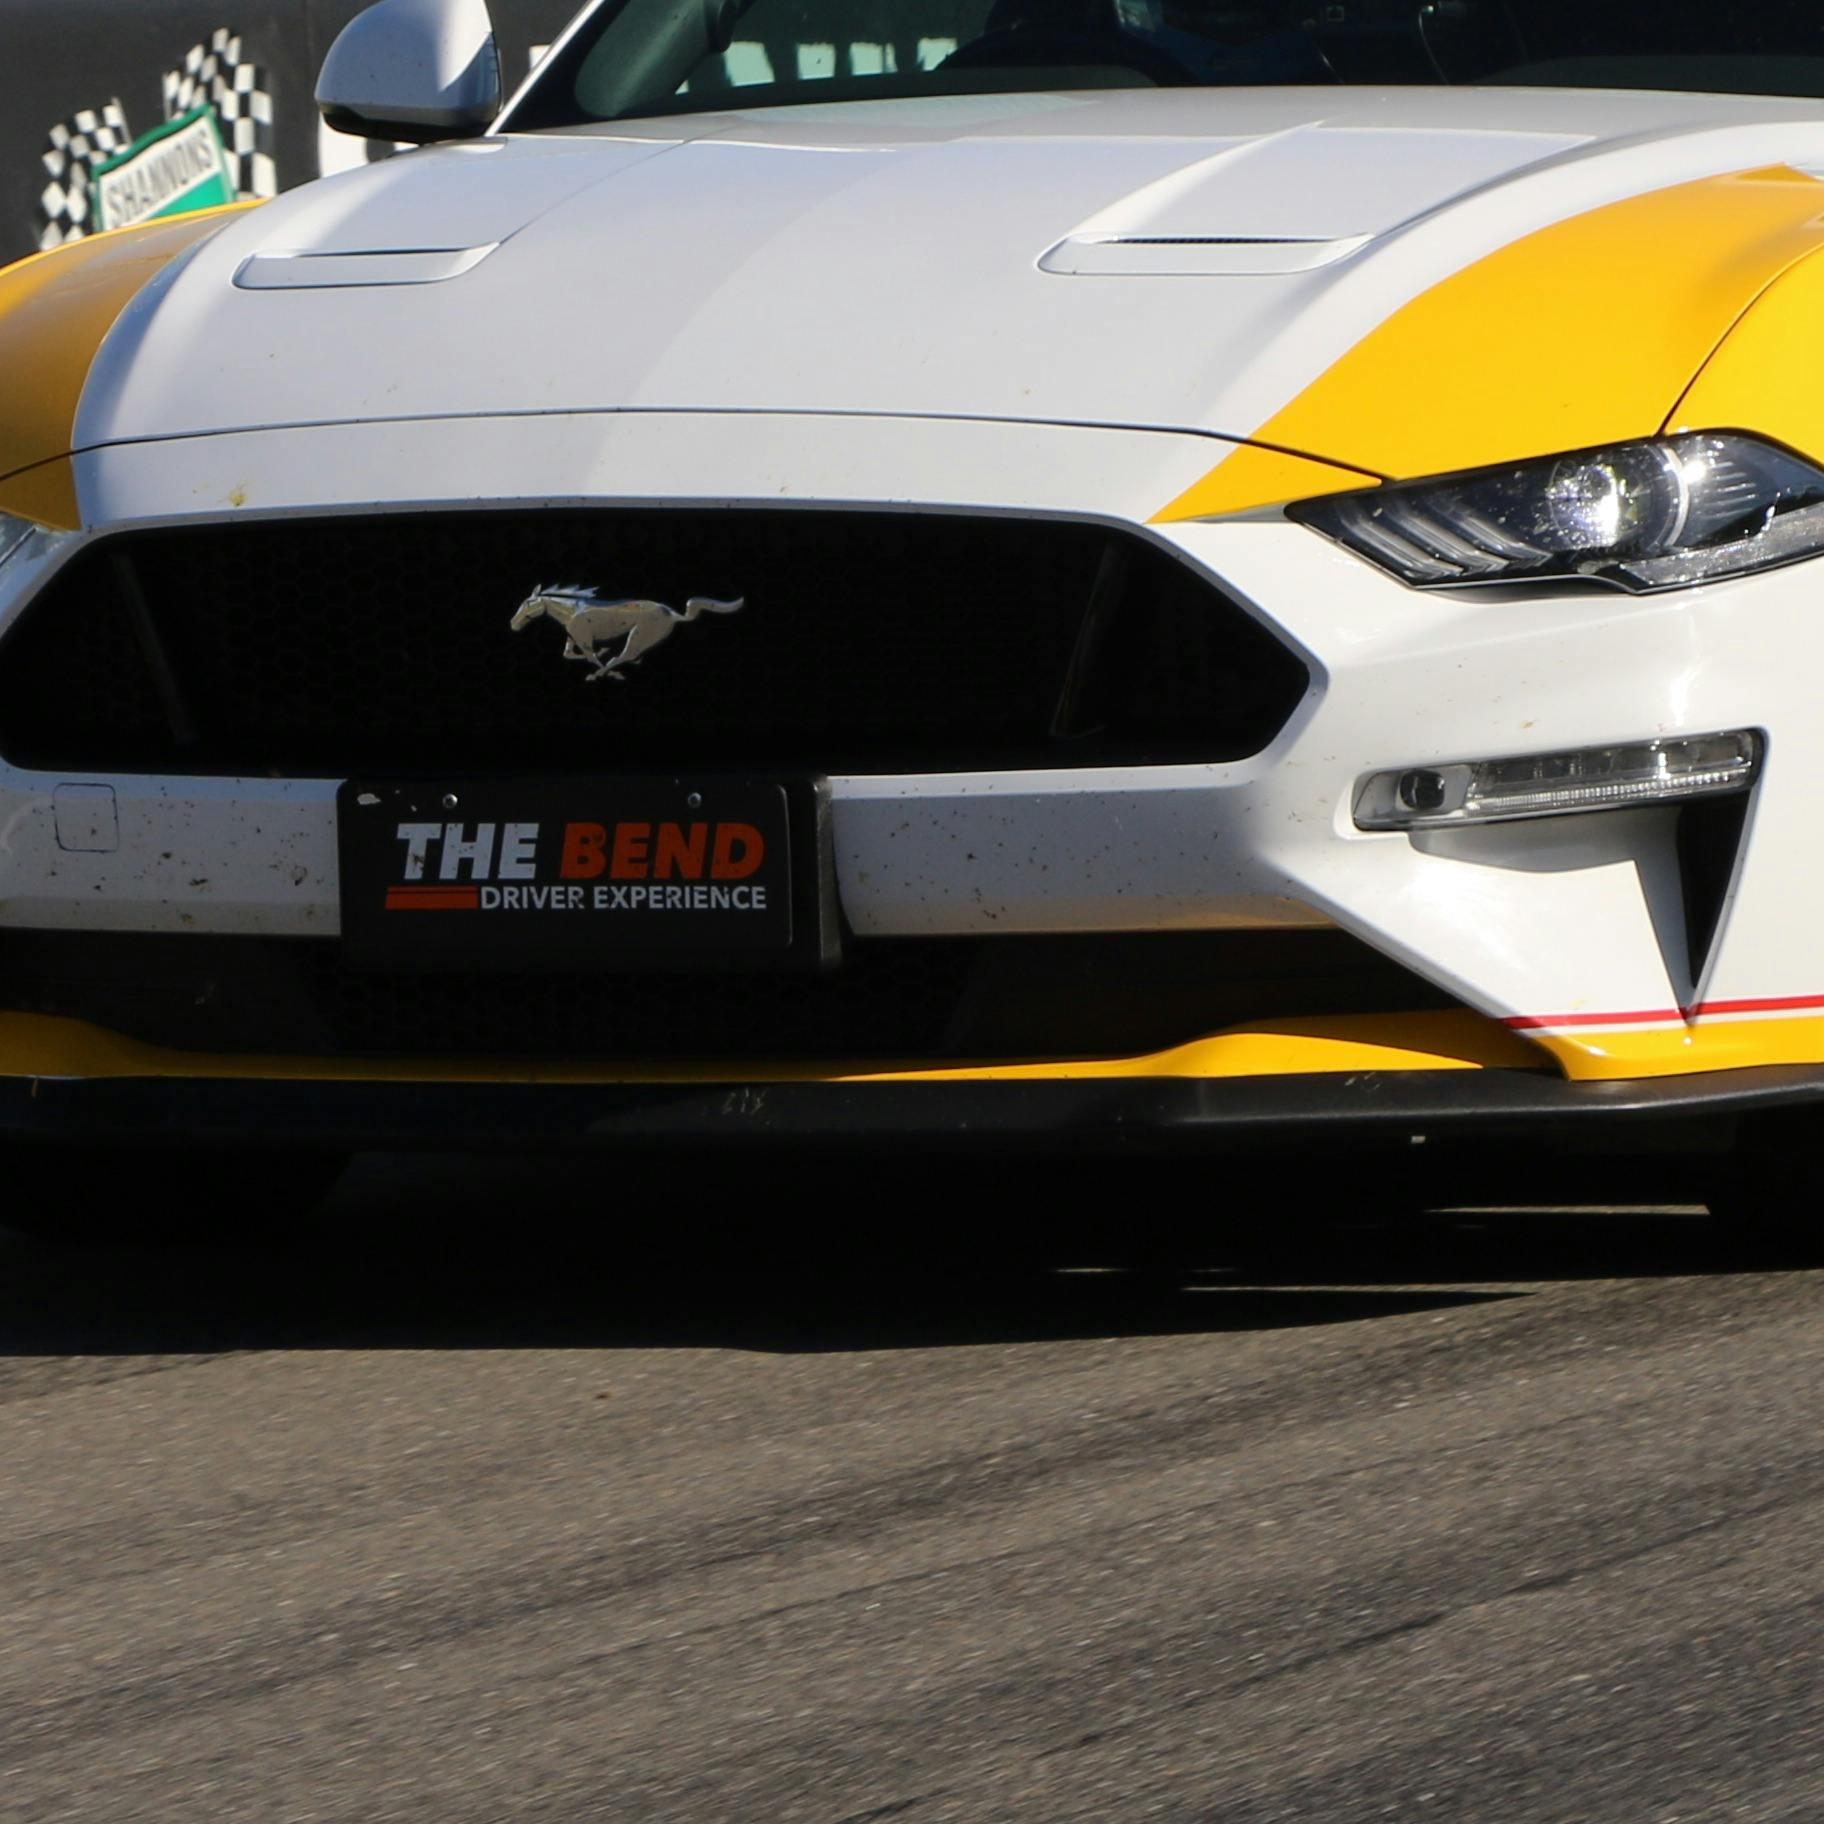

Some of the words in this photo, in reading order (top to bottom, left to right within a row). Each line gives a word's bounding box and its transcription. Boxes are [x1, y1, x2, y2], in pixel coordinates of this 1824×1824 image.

[395, 822, 540, 880] THE
[559, 822, 765, 880] BEND
[480, 886, 585, 910] DRIVER
[593, 885, 768, 910] EXPERIENCE
